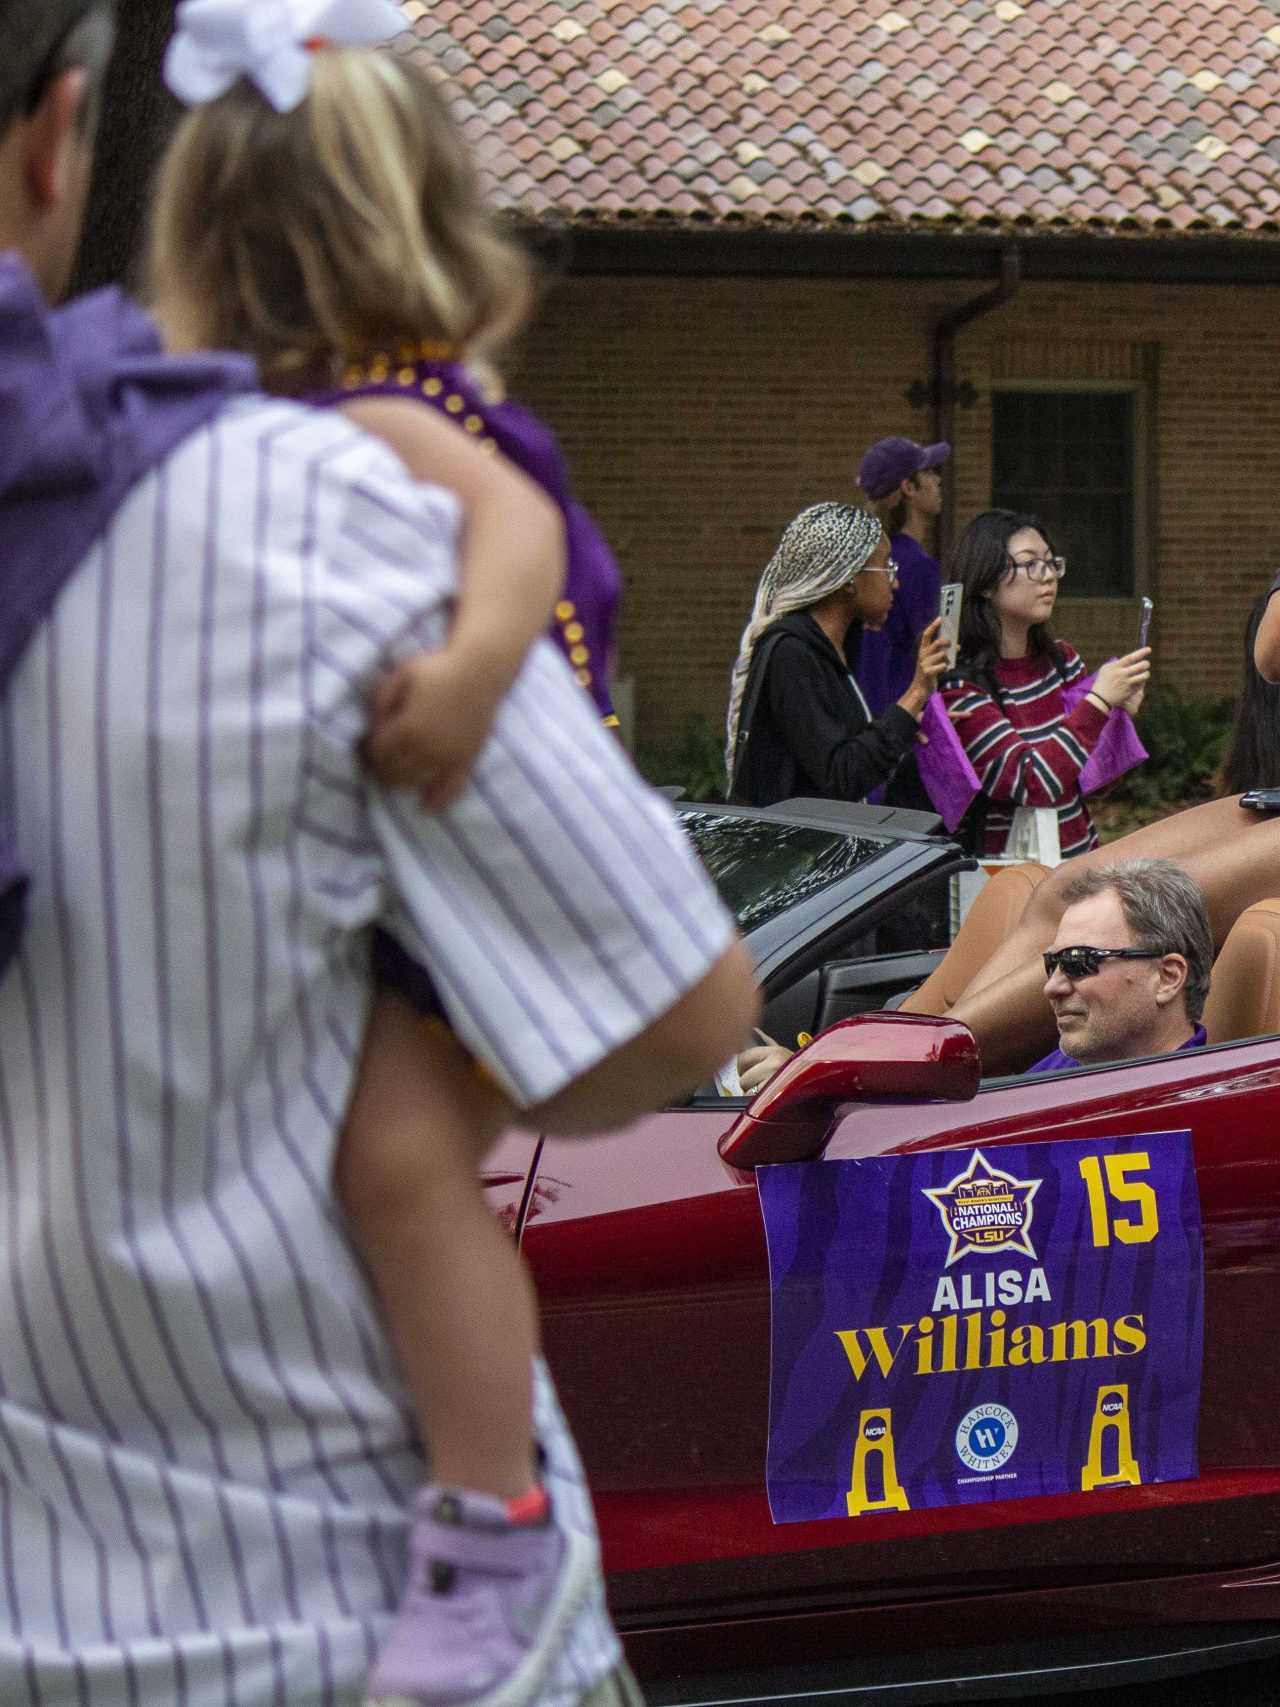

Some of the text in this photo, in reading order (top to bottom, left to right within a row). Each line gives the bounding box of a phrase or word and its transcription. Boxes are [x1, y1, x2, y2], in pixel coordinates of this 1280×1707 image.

[957, 1201, 1014, 1217] NATIONAL
[1079, 1152, 1159, 1247] 15
[953, 1212, 1023, 1231] CHAMPIONS
[975, 1231, 1004, 1243] LSU
[931, 1267, 1052, 1312] ALISA
[833, 1309, 1147, 1382] Williams
[960, 1406, 1014, 1434] HANCOCK
[960, 1440, 1013, 1469] WHITNEY
